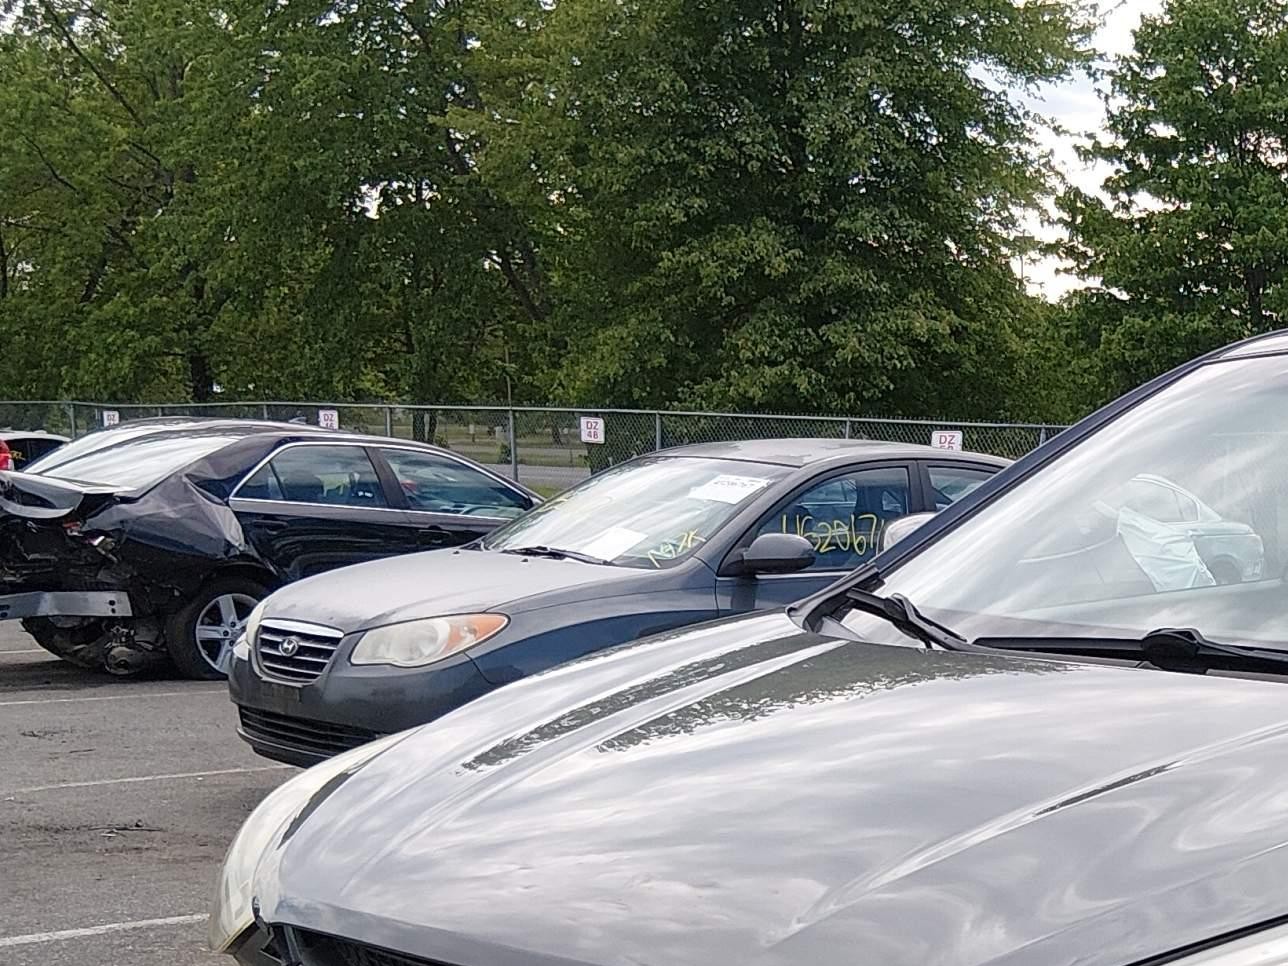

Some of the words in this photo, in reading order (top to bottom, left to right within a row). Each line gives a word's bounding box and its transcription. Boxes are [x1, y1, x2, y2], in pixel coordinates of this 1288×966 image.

[323, 413, 334, 422] DZ
[586, 420, 599, 430] DZ
[938, 434, 956, 445] DZ
